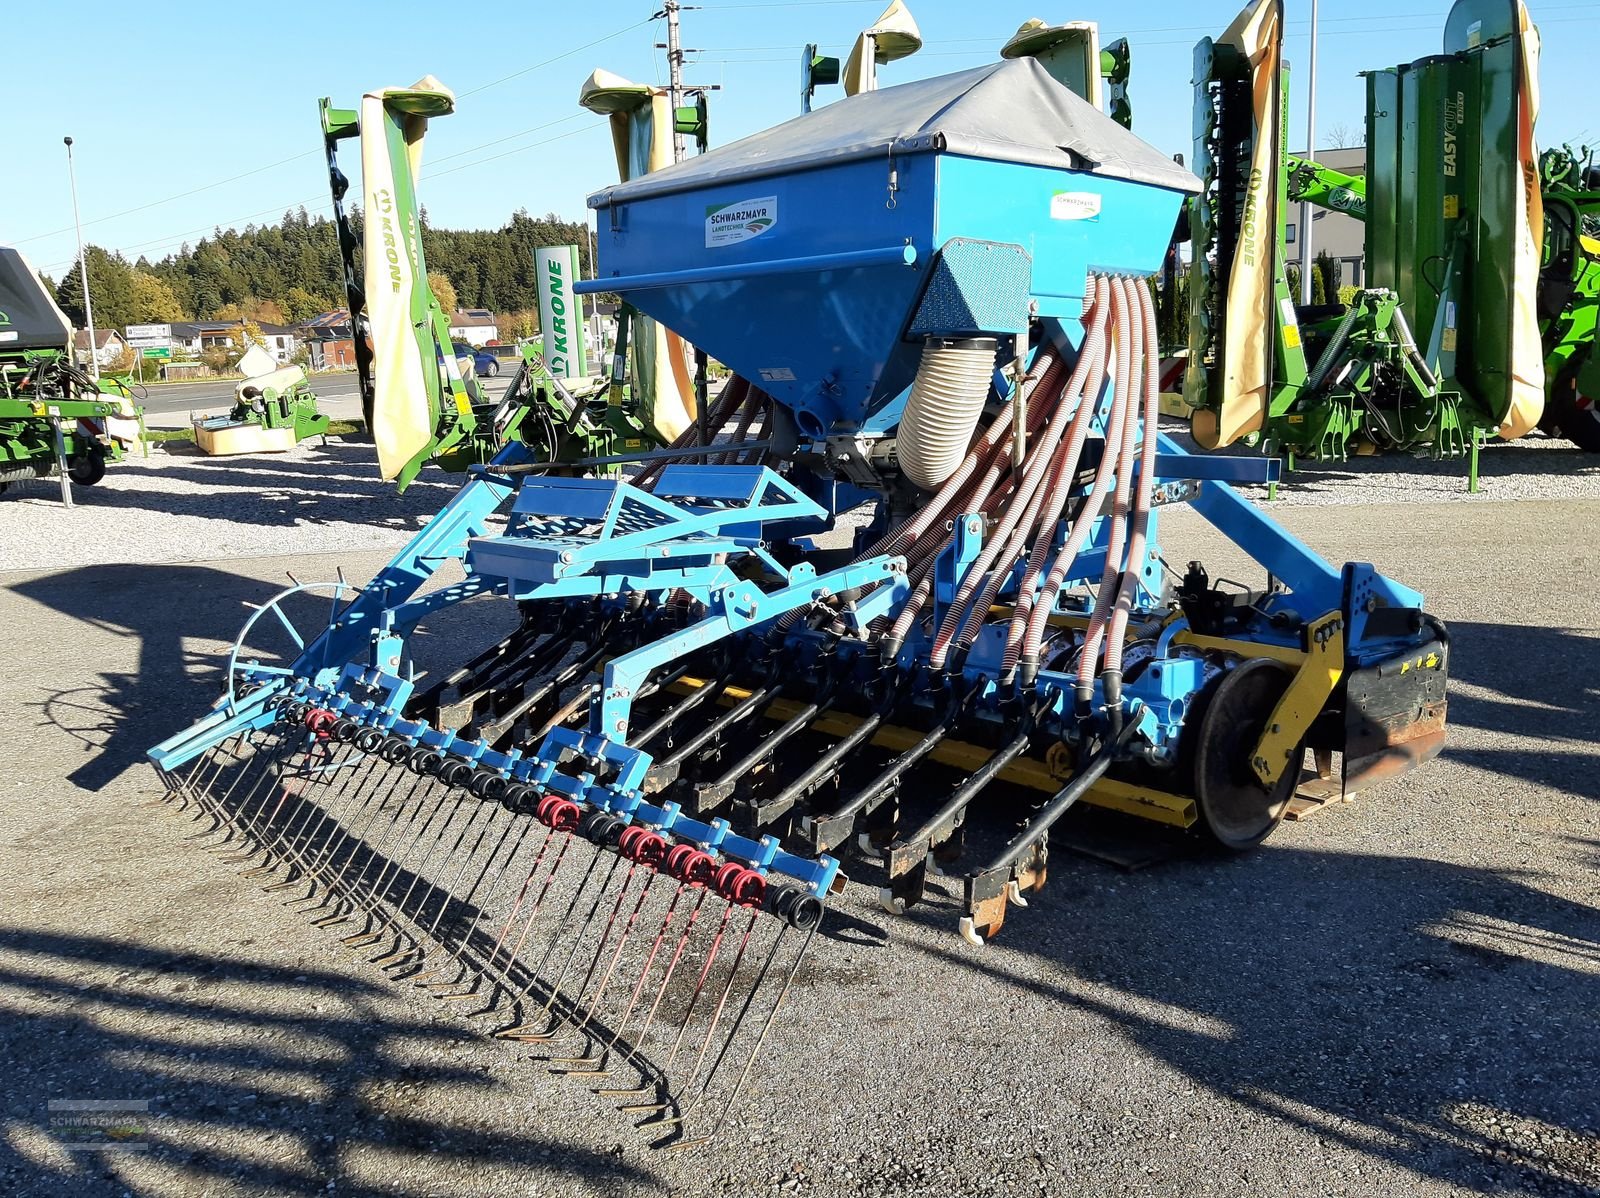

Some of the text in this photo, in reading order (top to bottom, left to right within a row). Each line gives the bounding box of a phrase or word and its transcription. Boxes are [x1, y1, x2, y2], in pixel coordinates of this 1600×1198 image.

[1443, 98, 1457, 177] EASYCUT
[381, 216, 401, 294] KRONE
[711, 208, 767, 224] SCHWARZMAYR
[1244, 193, 1257, 267] KRONE
[548, 259, 568, 353] KRONE
